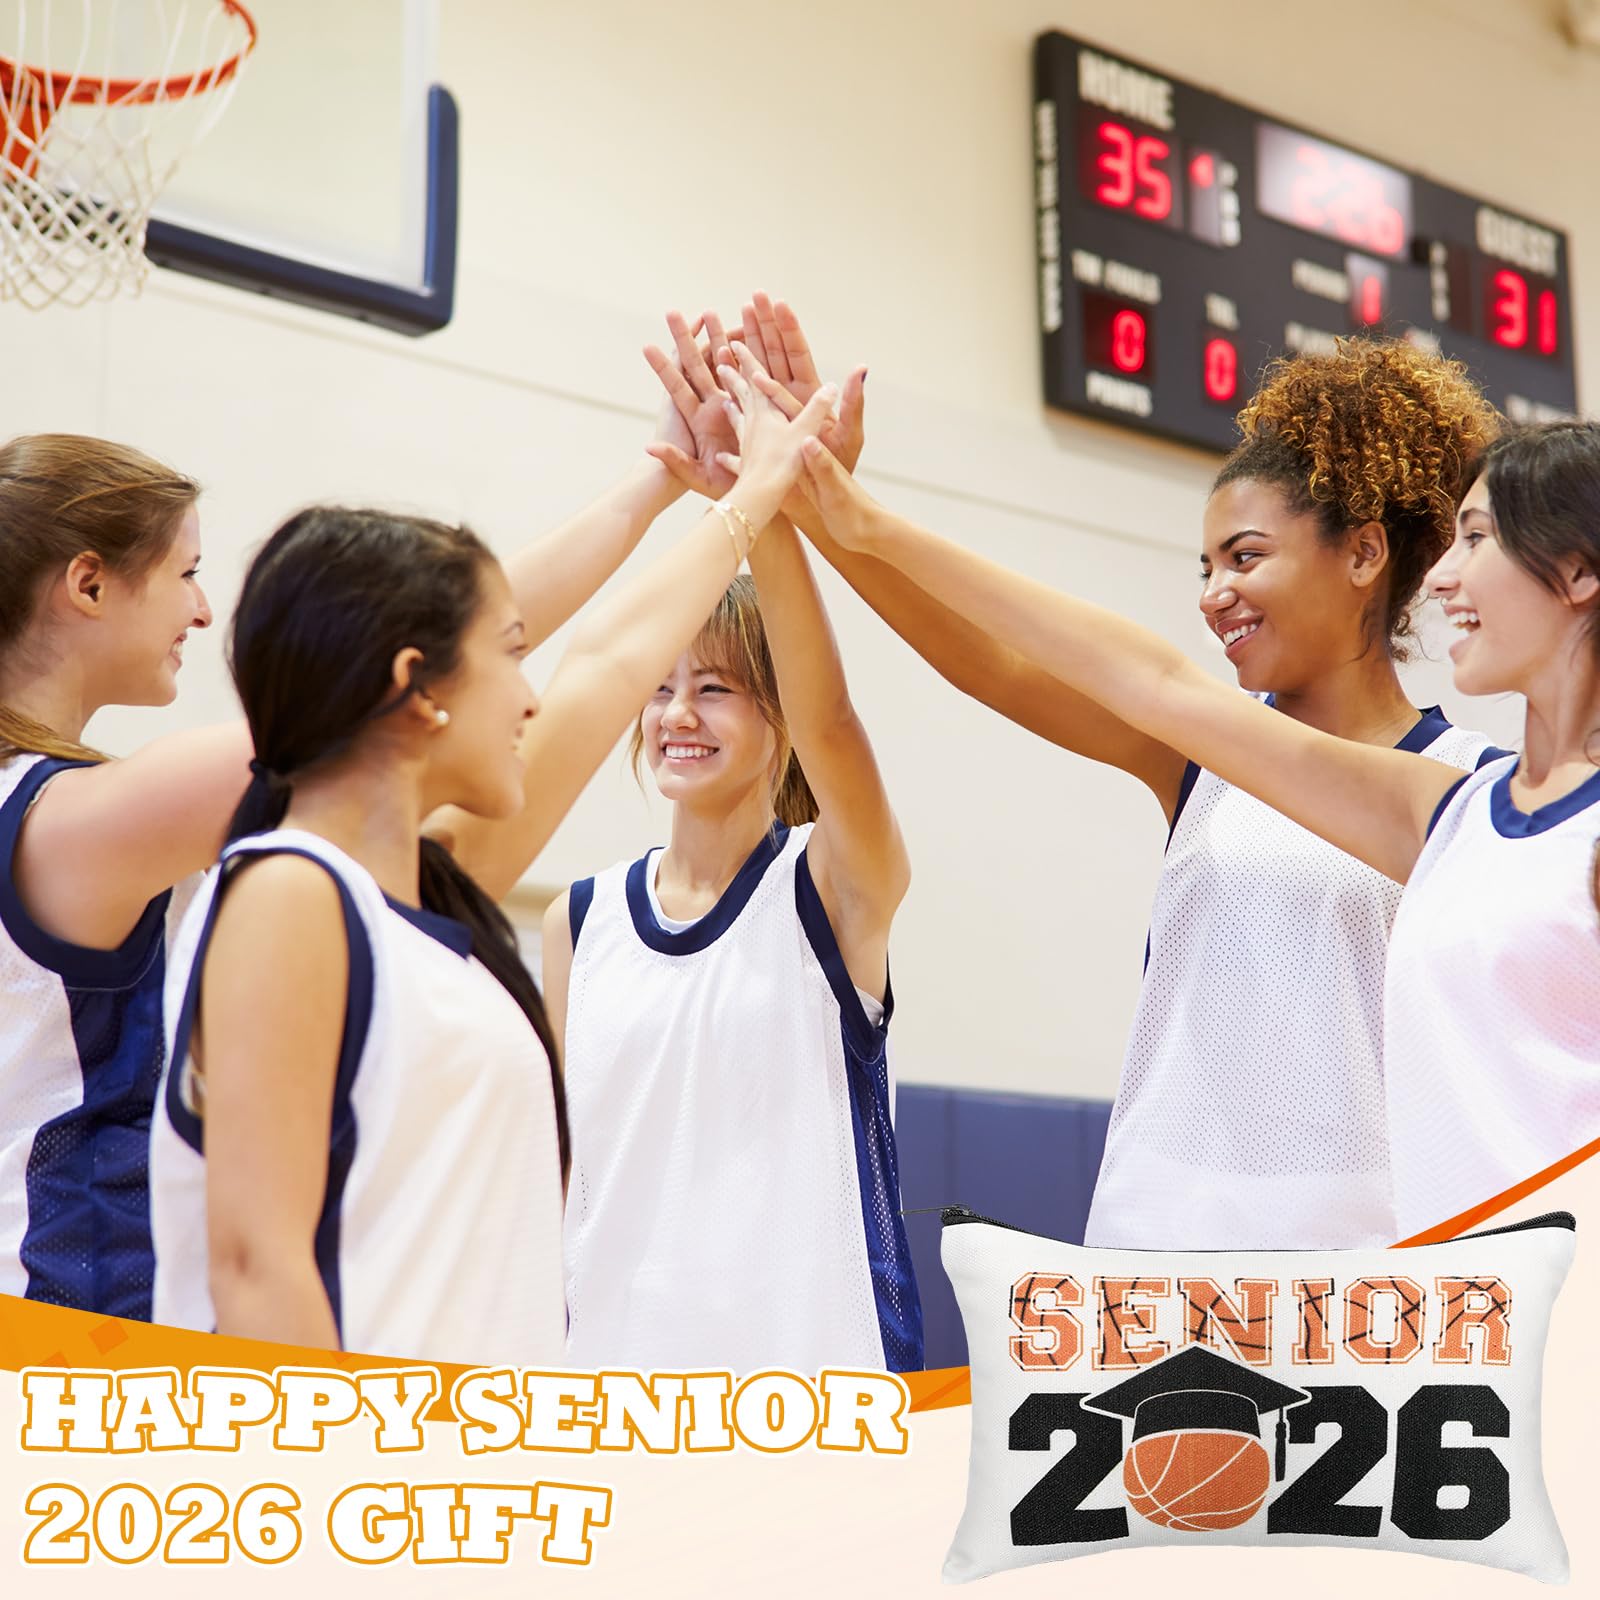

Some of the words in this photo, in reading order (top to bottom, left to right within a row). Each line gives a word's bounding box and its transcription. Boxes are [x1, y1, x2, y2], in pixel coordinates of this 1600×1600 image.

[1097, 122, 1172, 220] 35
[1112, 309, 1146, 372] 0
[1495, 268, 1557, 356] 31
[1204, 338, 1237, 401] 0
[1008, 1272, 1513, 1371] SENIOR
